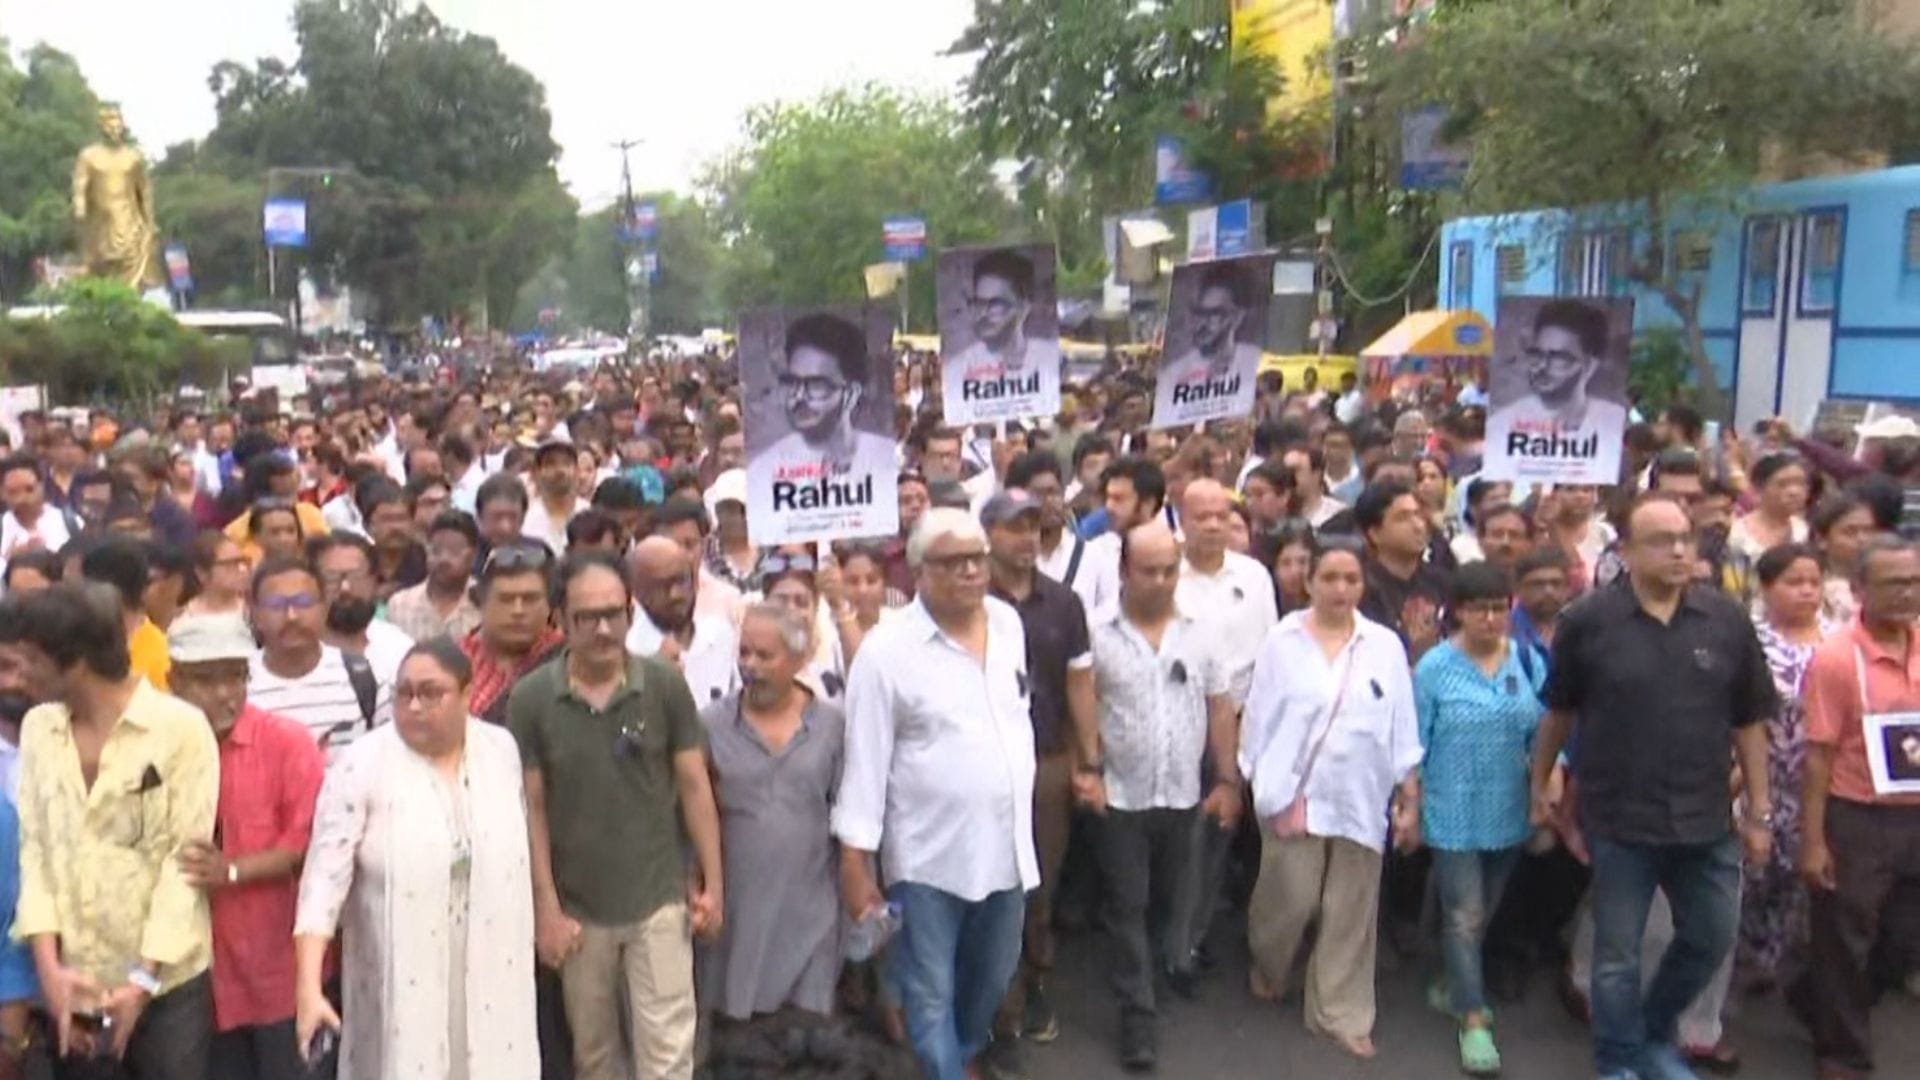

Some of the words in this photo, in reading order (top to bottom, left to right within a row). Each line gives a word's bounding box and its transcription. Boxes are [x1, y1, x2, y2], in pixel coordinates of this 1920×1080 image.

[963, 369, 1039, 401] Rahul
[1173, 373, 1240, 405] Rahul
[1507, 431, 1598, 458] Rahul
[773, 474, 872, 511] Rahul
